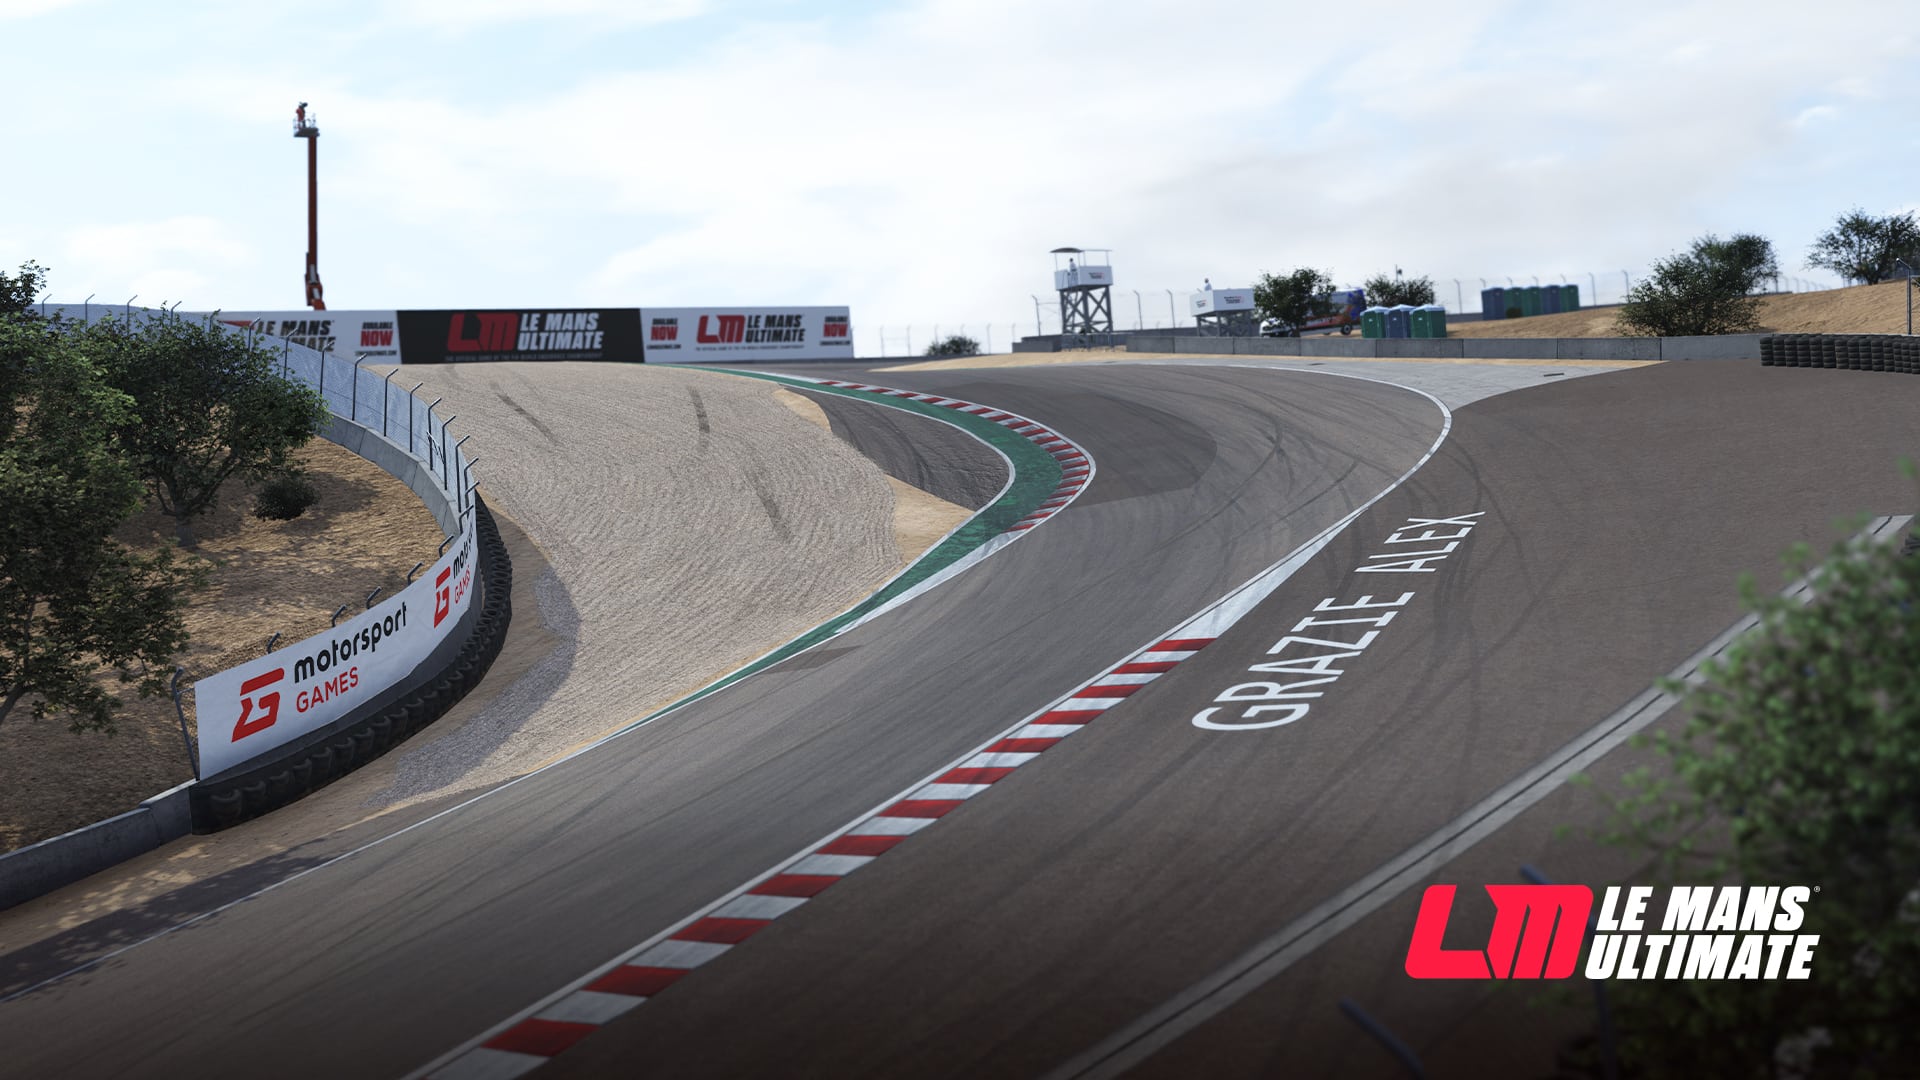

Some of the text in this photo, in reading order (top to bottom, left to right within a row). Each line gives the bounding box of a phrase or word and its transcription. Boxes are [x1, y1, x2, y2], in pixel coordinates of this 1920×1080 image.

[279, 320, 332, 336] MANS
[520, 312, 600, 332] LE MANS
[747, 314, 803, 329] LE MANS
[360, 330, 394, 347] NOW
[651, 326, 679, 341] NOW
[745, 328, 805, 344] ULTIMATE
[823, 323, 849, 338] NOW
[517, 331, 604, 352] ULTIMATE
[1192, 511, 1486, 730] GRAZIE ALEX
[294, 601, 407, 684] motorsport
[296, 666, 359, 713] GAMES
